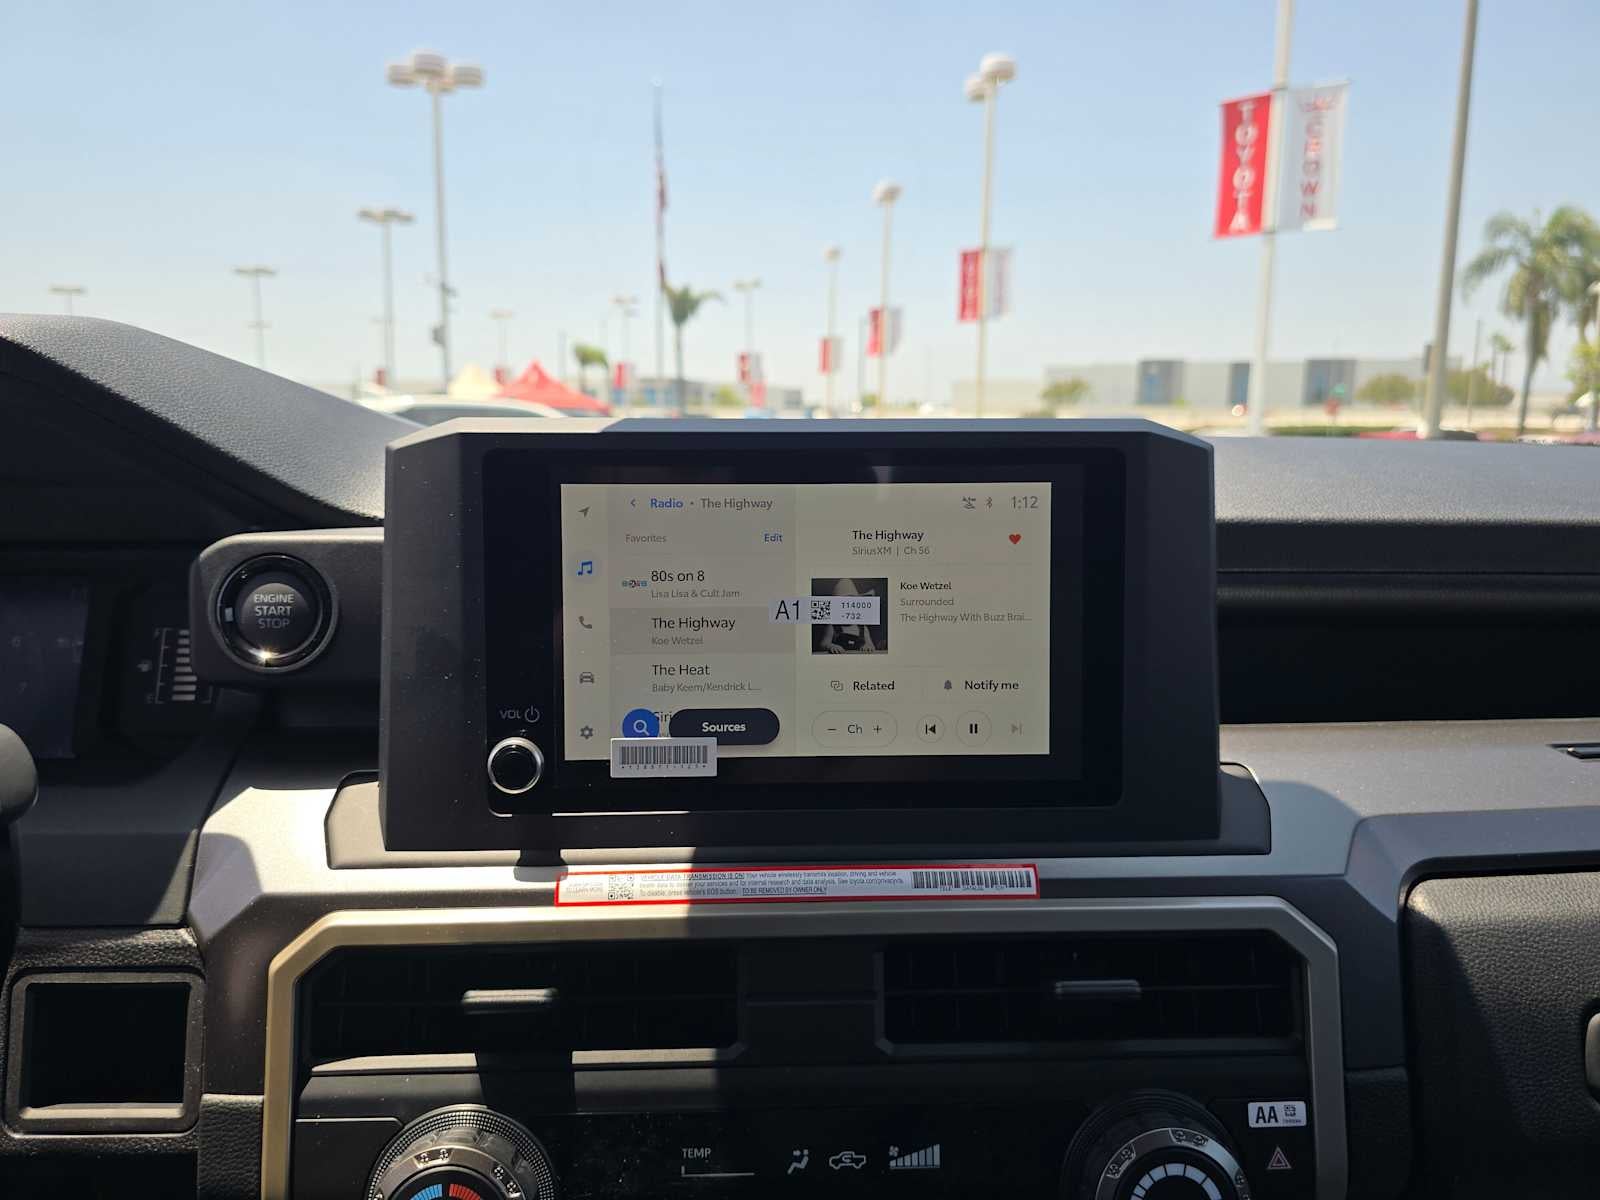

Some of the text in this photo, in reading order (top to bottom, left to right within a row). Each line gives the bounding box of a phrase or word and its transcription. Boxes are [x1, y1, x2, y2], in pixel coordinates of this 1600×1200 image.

[1228, 101, 1260, 233] TOYOTA
[650, 498, 773, 512] Radio The Highway
[1011, 496, 1038, 508] 1:12
[625, 533, 668, 543] Favorites
[764, 533, 783, 543] Edit
[852, 530, 924, 542] The Highway
[852, 546, 892, 556] SiriusXM
[903, 546, 917, 556] Ch
[651, 570, 705, 582] 80s on 8
[900, 582, 952, 591] Koe Wetzel
[254, 593, 295, 604] ENGINE
[651, 589, 670, 599] Lisa
[671, 589, 689, 599] Lisa
[691, 590, 698, 598] &
[900, 597, 954, 607] Surrounded
[255, 605, 293, 617] START
[775, 599, 799, 621] A1
[258, 617, 290, 629] STOP
[900, 613, 917, 623] The
[918, 613, 958, 625] Highway
[959, 612, 982, 622] With
[984, 612, 1005, 622] Buzz
[652, 617, 735, 632] The Highway
[652, 636, 704, 646] Koe Wetzel
[652, 664, 711, 676] The Heat
[652, 683, 675, 694] Baby
[853, 681, 895, 691] Related
[965, 680, 1019, 693] Notify me
[499, 709, 522, 720] VOL
[653, 711, 672, 722] Siri
[702, 722, 746, 733] Sources
[847, 724, 863, 735] Ch
[1255, 1105, 1279, 1124] AA
[682, 1147, 712, 1159] TEMP
